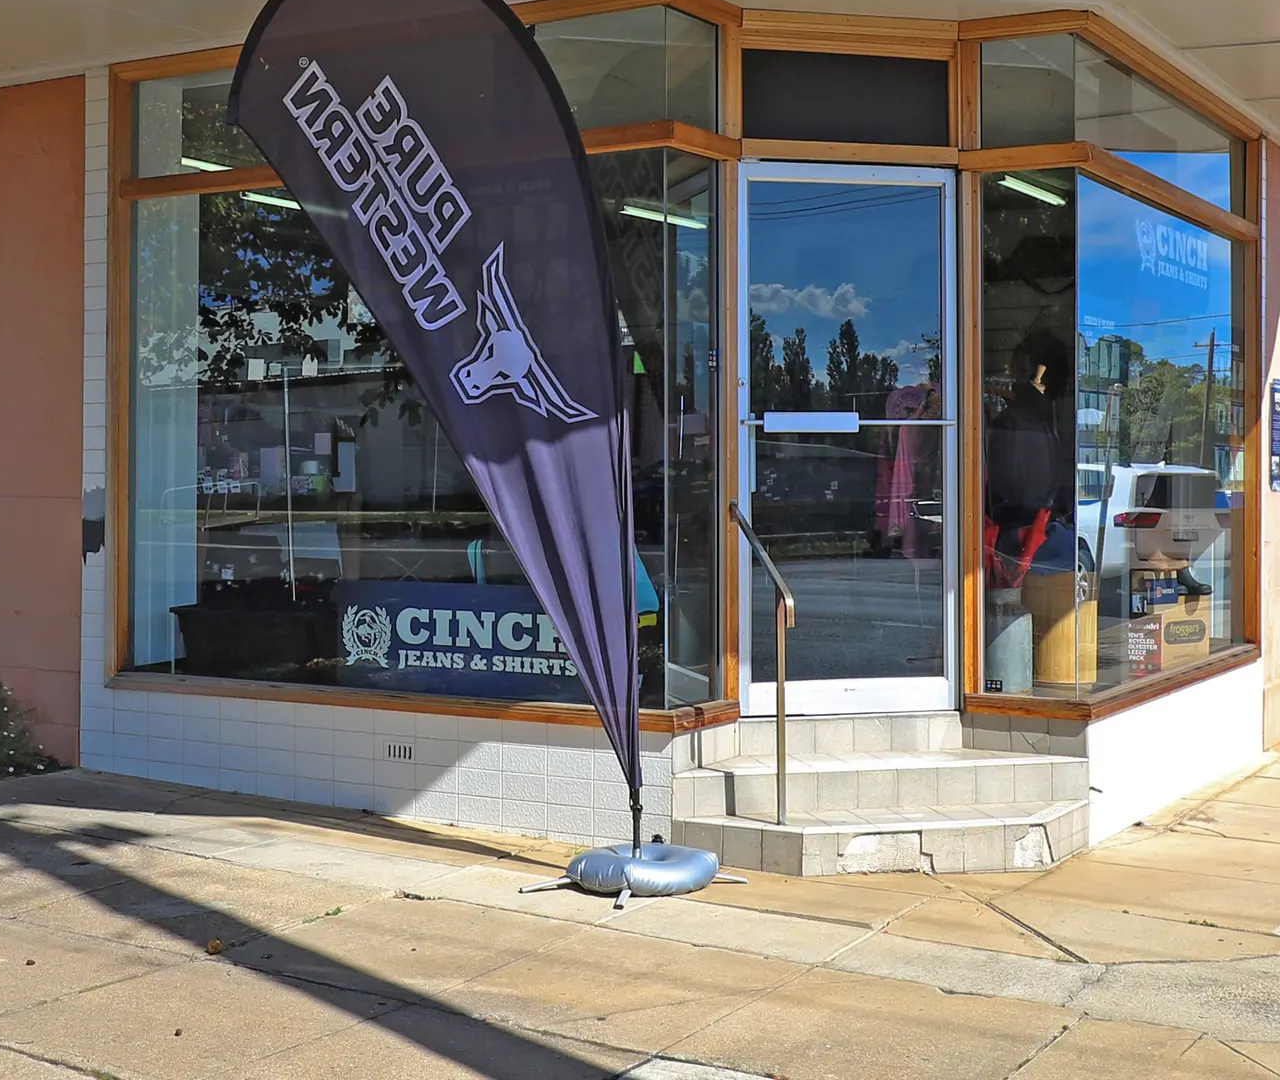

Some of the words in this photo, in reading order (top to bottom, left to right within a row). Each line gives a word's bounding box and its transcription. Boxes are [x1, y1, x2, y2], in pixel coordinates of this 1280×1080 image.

[1156, 224, 1208, 271] CINCH
[1157, 260, 1178, 280] JEANS
[1169, 623, 1199, 636] froggers
[356, 649, 378, 658] CINCH
[398, 650, 465, 670] JEANS
[470, 654, 487, 671] &
[492, 655, 578, 677] SHIRTS
